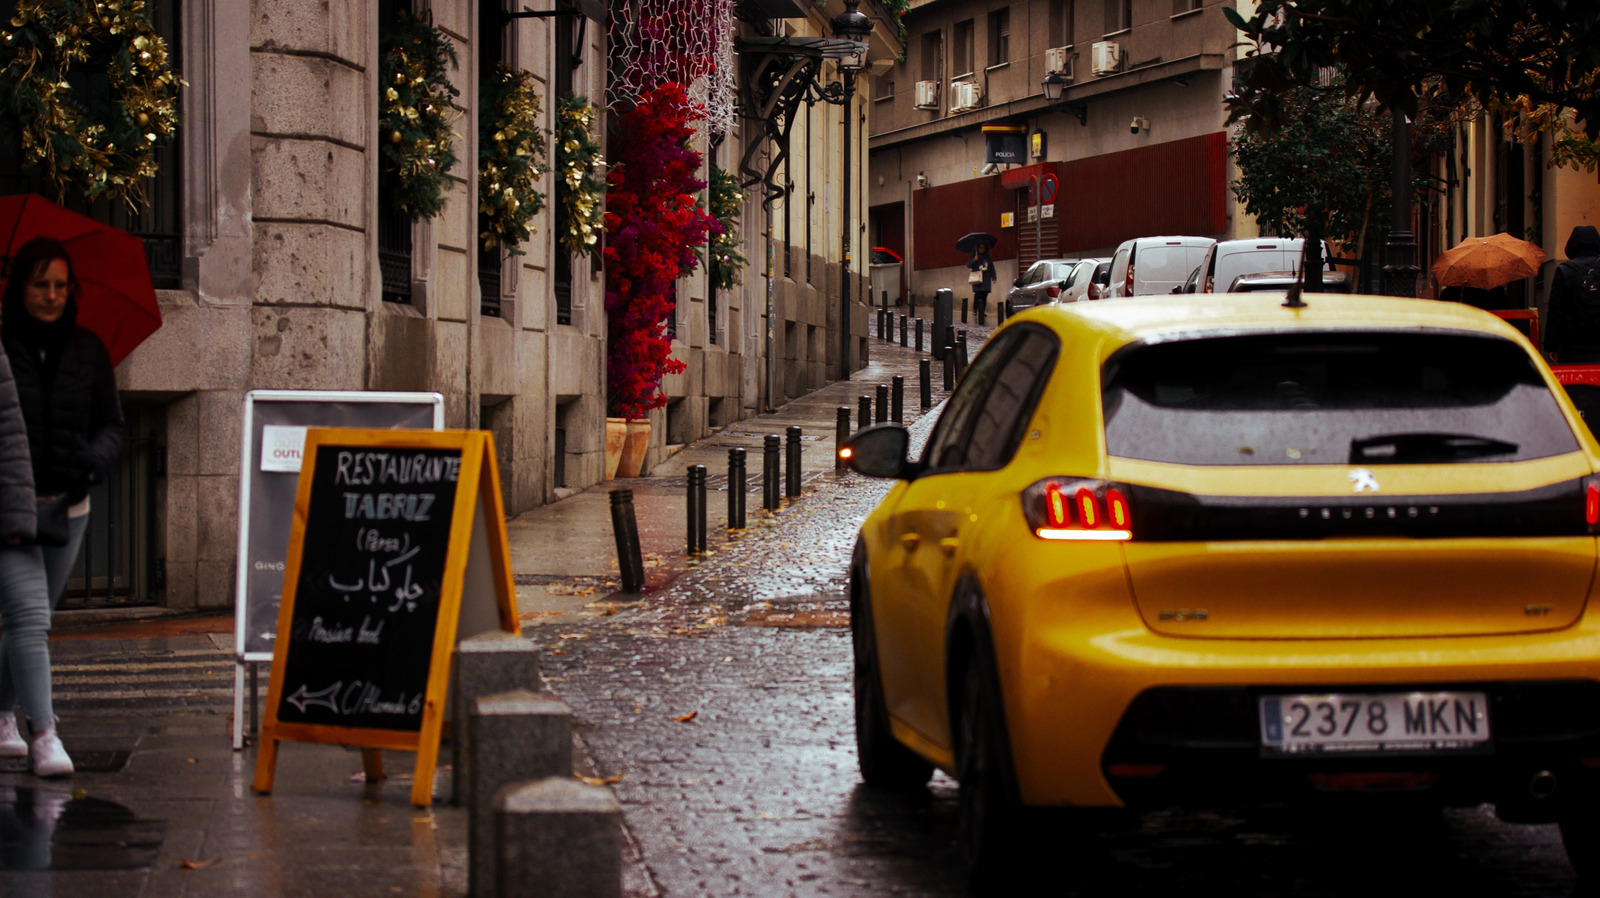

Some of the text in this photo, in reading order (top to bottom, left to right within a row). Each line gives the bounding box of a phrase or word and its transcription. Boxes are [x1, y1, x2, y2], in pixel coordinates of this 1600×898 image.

[334, 451, 462, 486] RESTAURANTE
[342, 492, 436, 521] TABRIZ
[407, 691, 422, 715] 6
[1290, 699, 1478, 737] 2378 MKN
